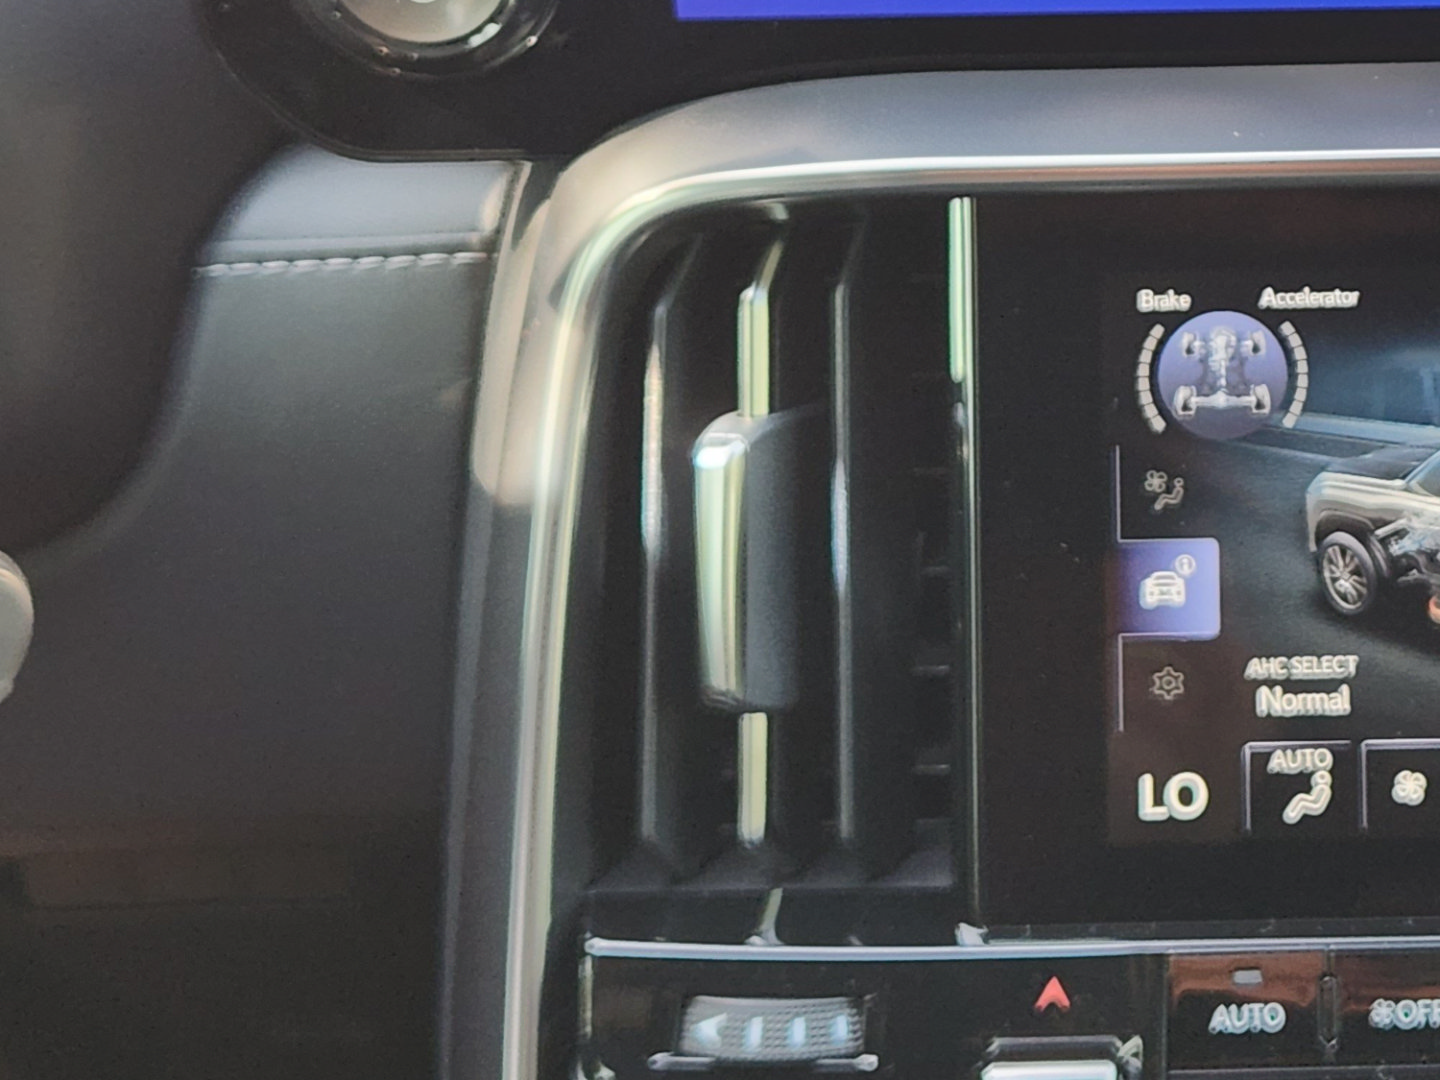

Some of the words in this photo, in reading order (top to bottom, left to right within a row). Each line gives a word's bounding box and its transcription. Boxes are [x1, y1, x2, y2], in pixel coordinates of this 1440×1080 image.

[1136, 288, 1192, 312] Brake
[1258, 286, 1360, 309] Accelerator
[1244, 656, 1288, 680] AHC
[1289, 655, 1359, 679] SELECT
[1255, 683, 1351, 717] Normal
[1266, 747, 1333, 774] AUTO
[1138, 771, 1209, 822] LO
[1208, 1001, 1287, 1034] AUTO
